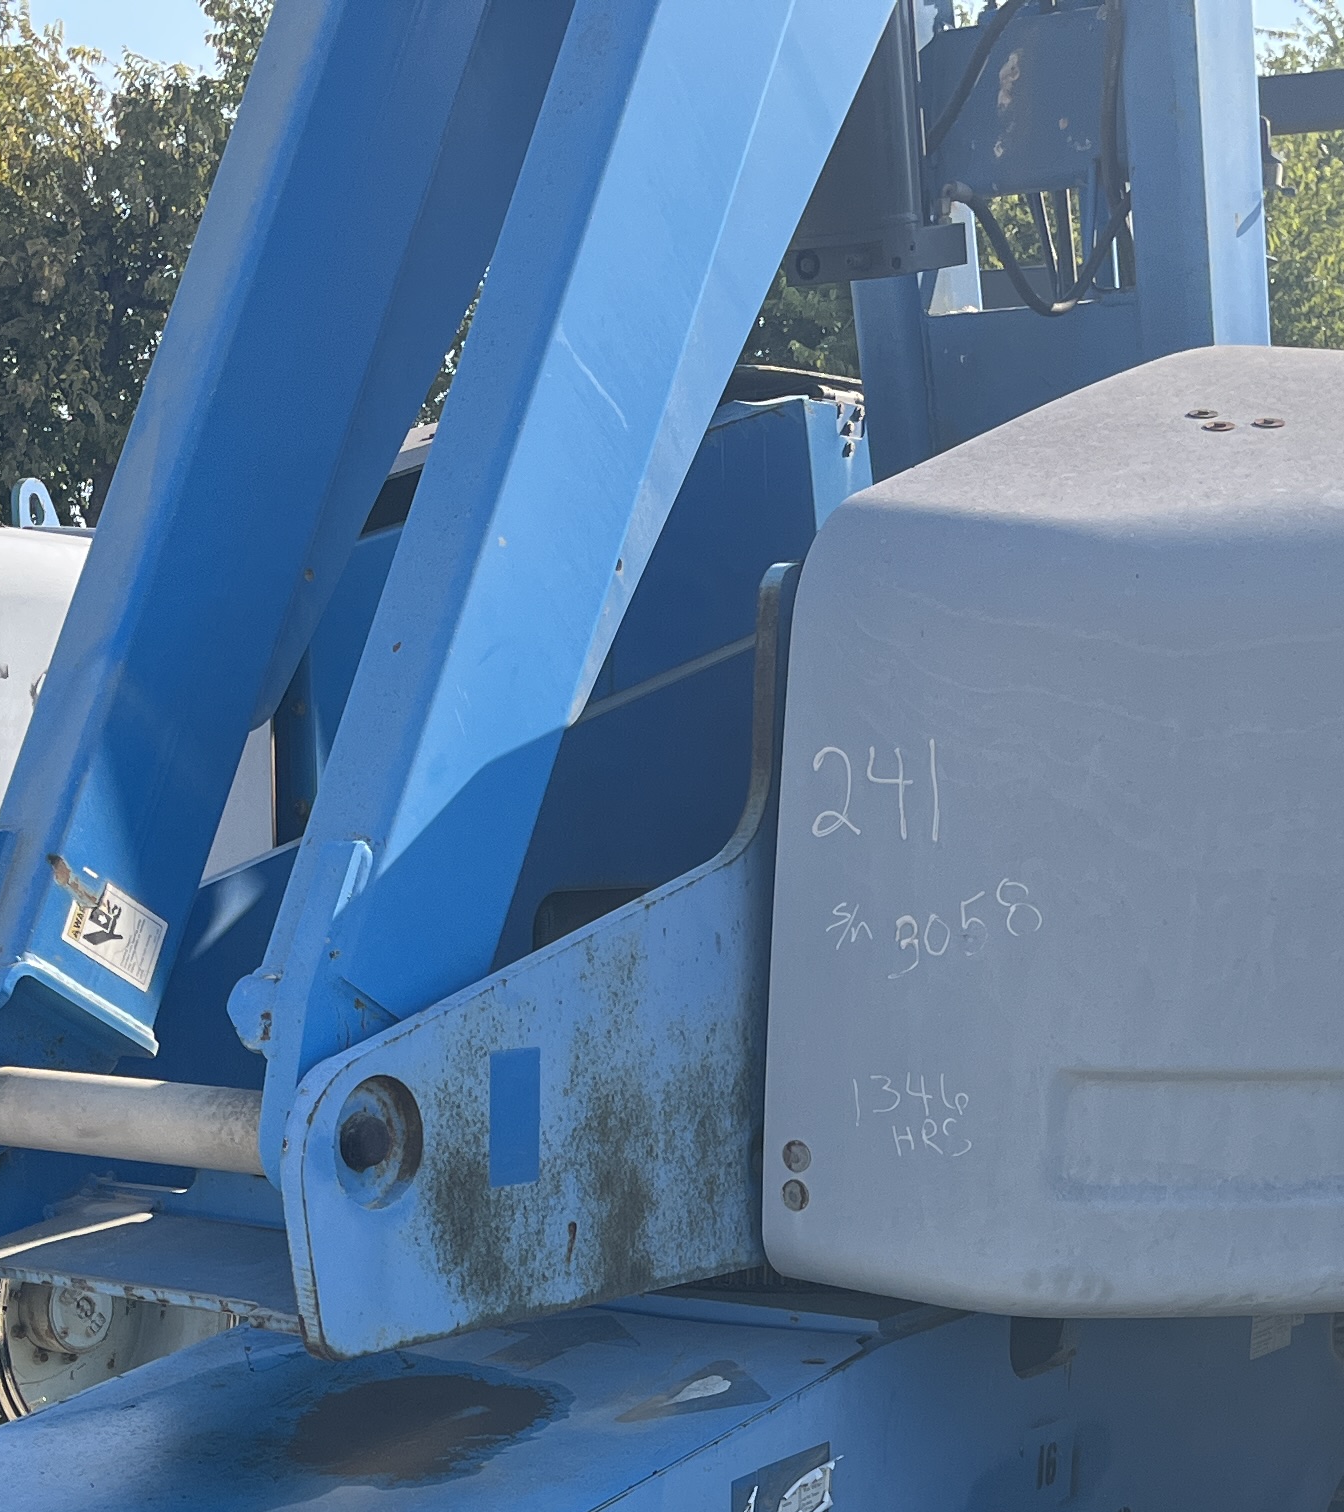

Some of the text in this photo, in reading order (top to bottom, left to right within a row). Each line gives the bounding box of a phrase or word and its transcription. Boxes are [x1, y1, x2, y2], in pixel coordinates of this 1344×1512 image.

[812, 738, 940, 842] 241
[853, 1071, 969, 1127] 1346
[1036, 1441, 1058, 1491] 16
